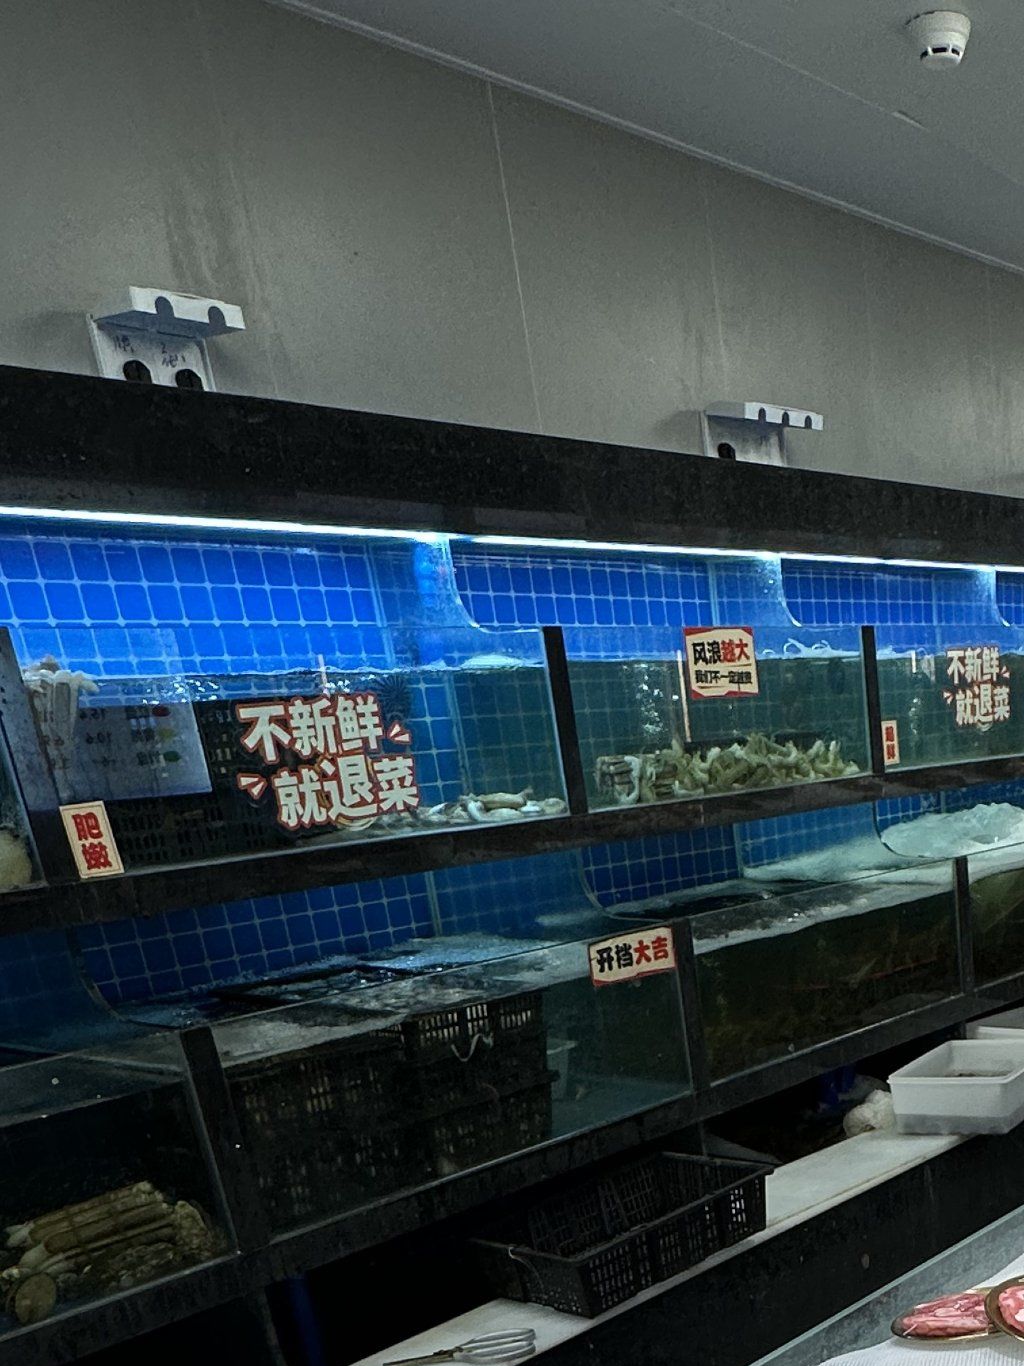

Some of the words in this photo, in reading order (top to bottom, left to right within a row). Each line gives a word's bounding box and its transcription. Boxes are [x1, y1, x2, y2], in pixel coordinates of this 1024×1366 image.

[692, 638, 750, 665] 风浪越大
[946, 646, 1000, 685] 不新鲜
[955, 682, 1011, 727] 就退菜
[237, 694, 385, 764] 不新鲜
[273, 753, 420, 829] 就退菜
[72, 812, 112, 870] 肥嫩
[596, 936, 669, 973] 开档大吉
